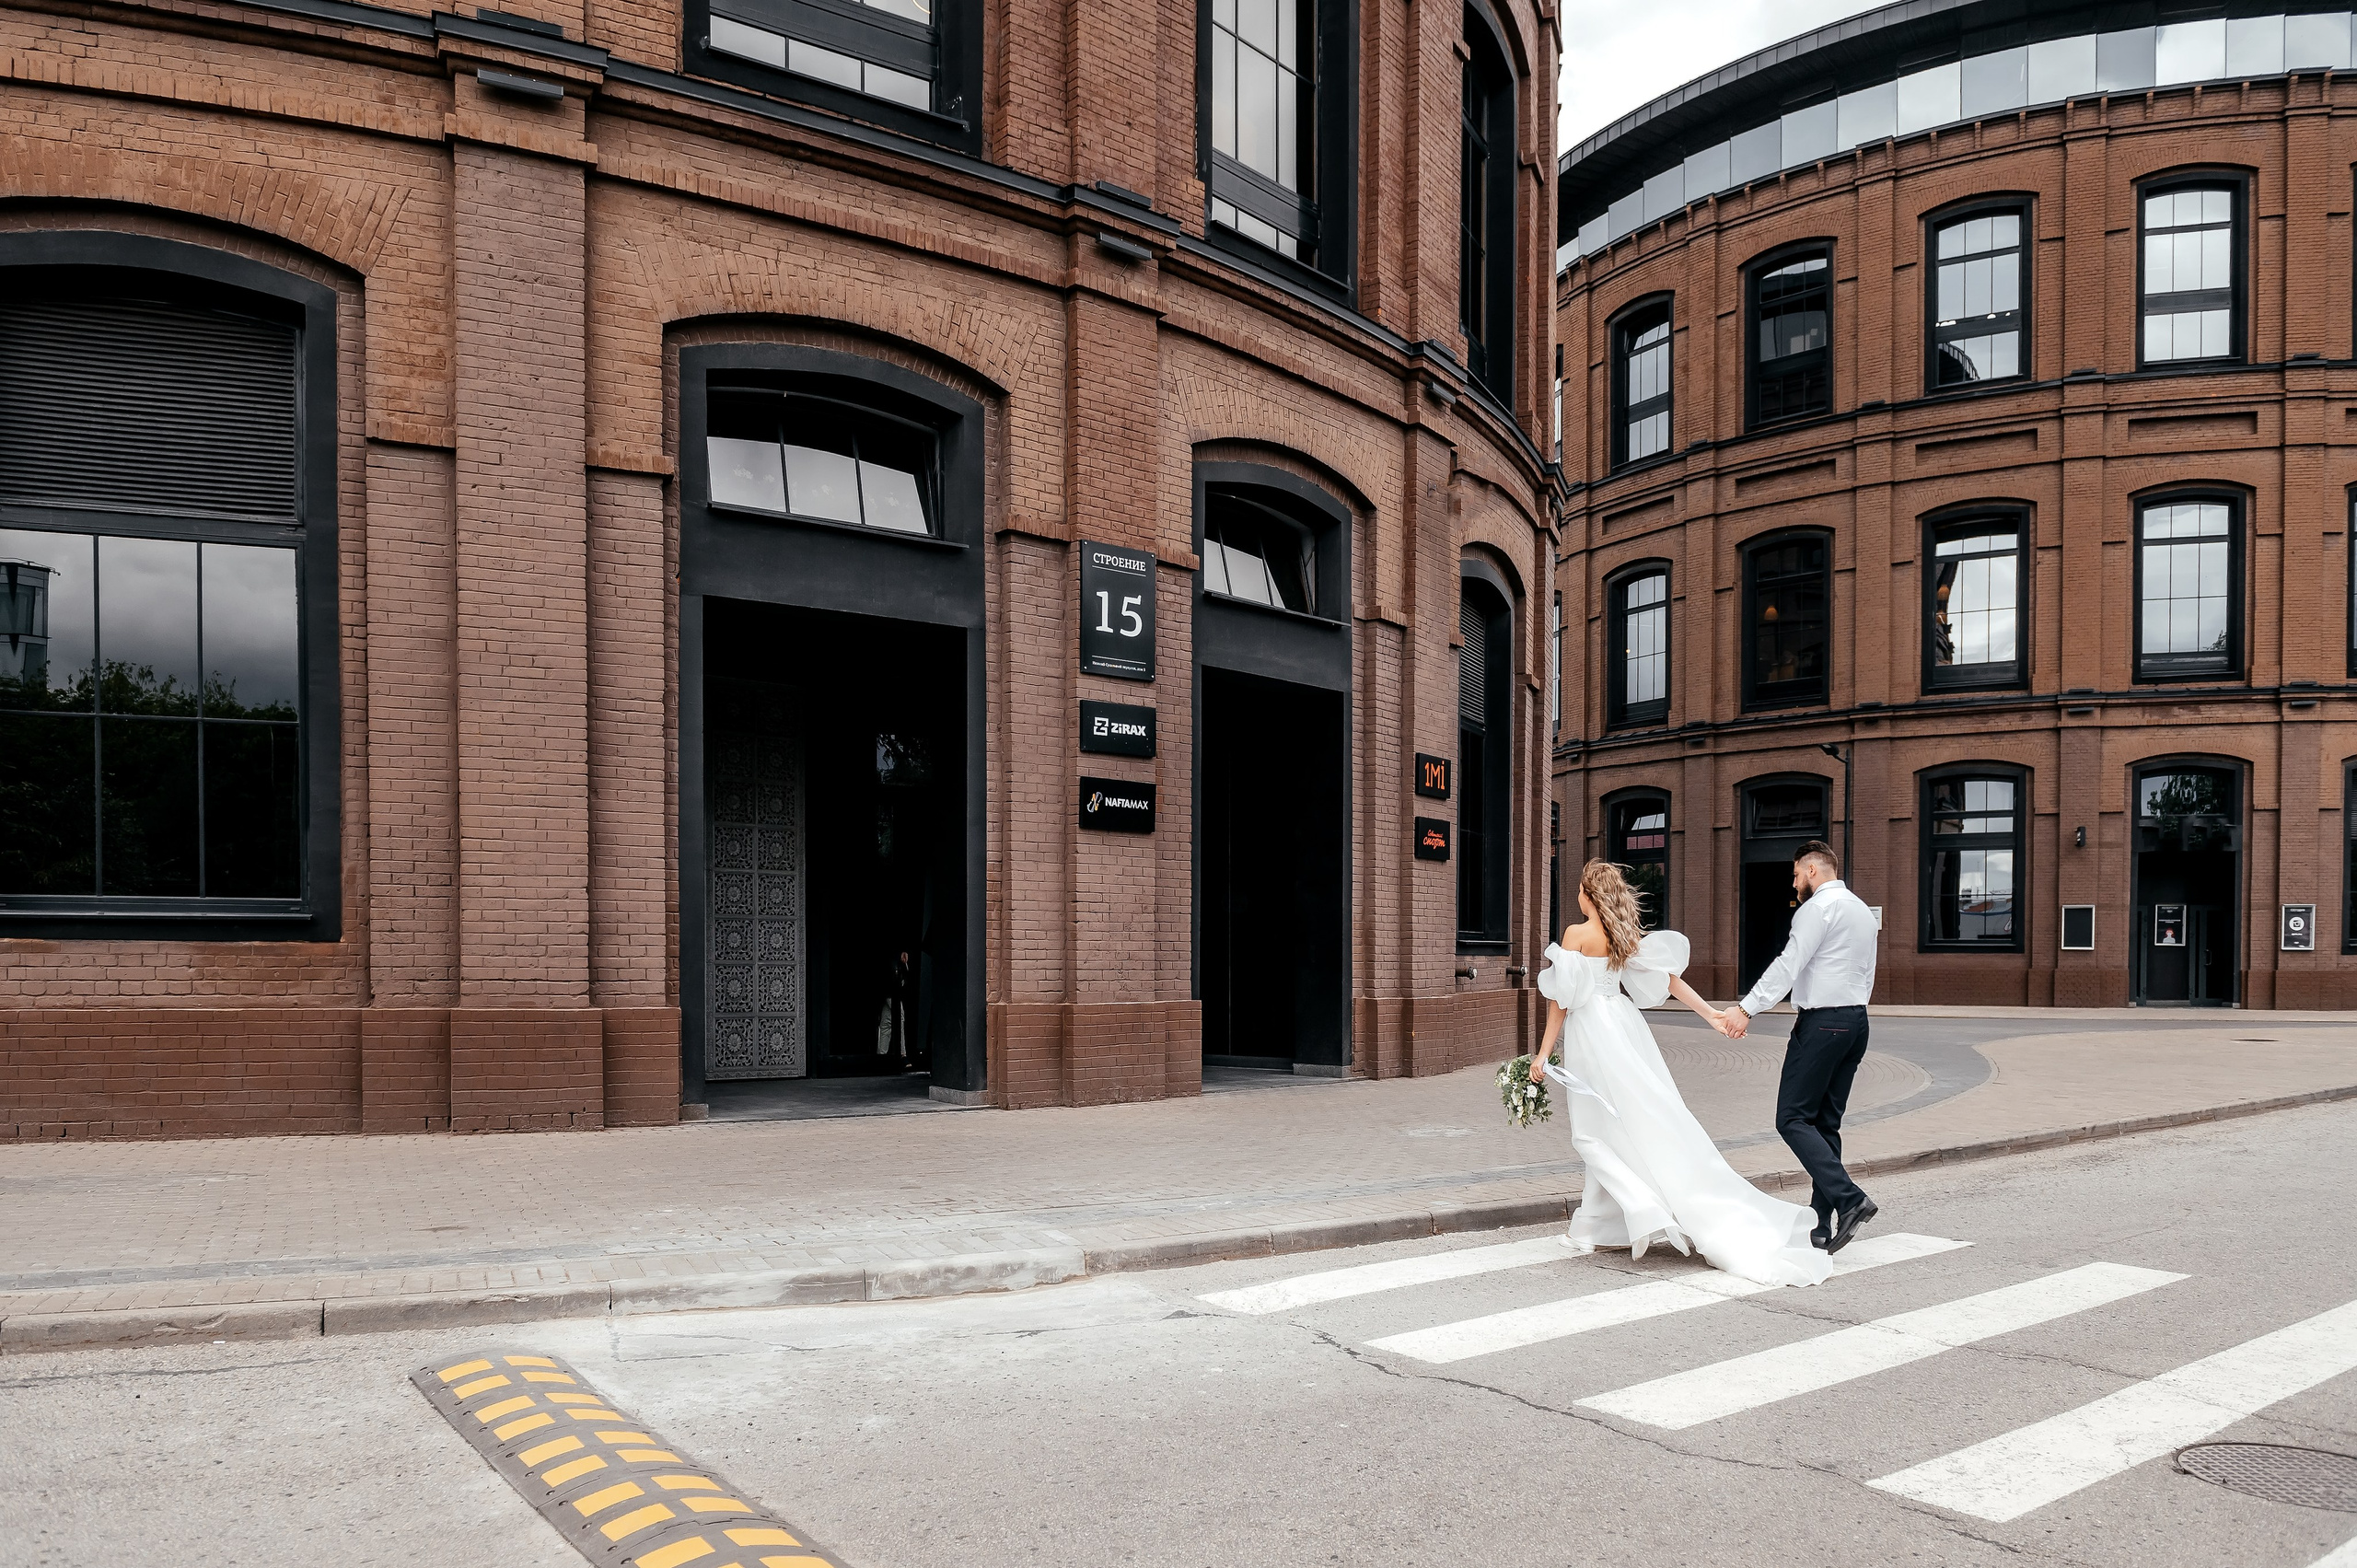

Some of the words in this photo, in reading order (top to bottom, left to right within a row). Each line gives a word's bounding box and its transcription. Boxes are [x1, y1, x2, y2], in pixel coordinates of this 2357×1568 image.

[1093, 552, 1146, 572] СТРОЕНИЕ
[1096, 591, 1143, 637] 15
[1105, 797, 1149, 810] NAFTAMAX
